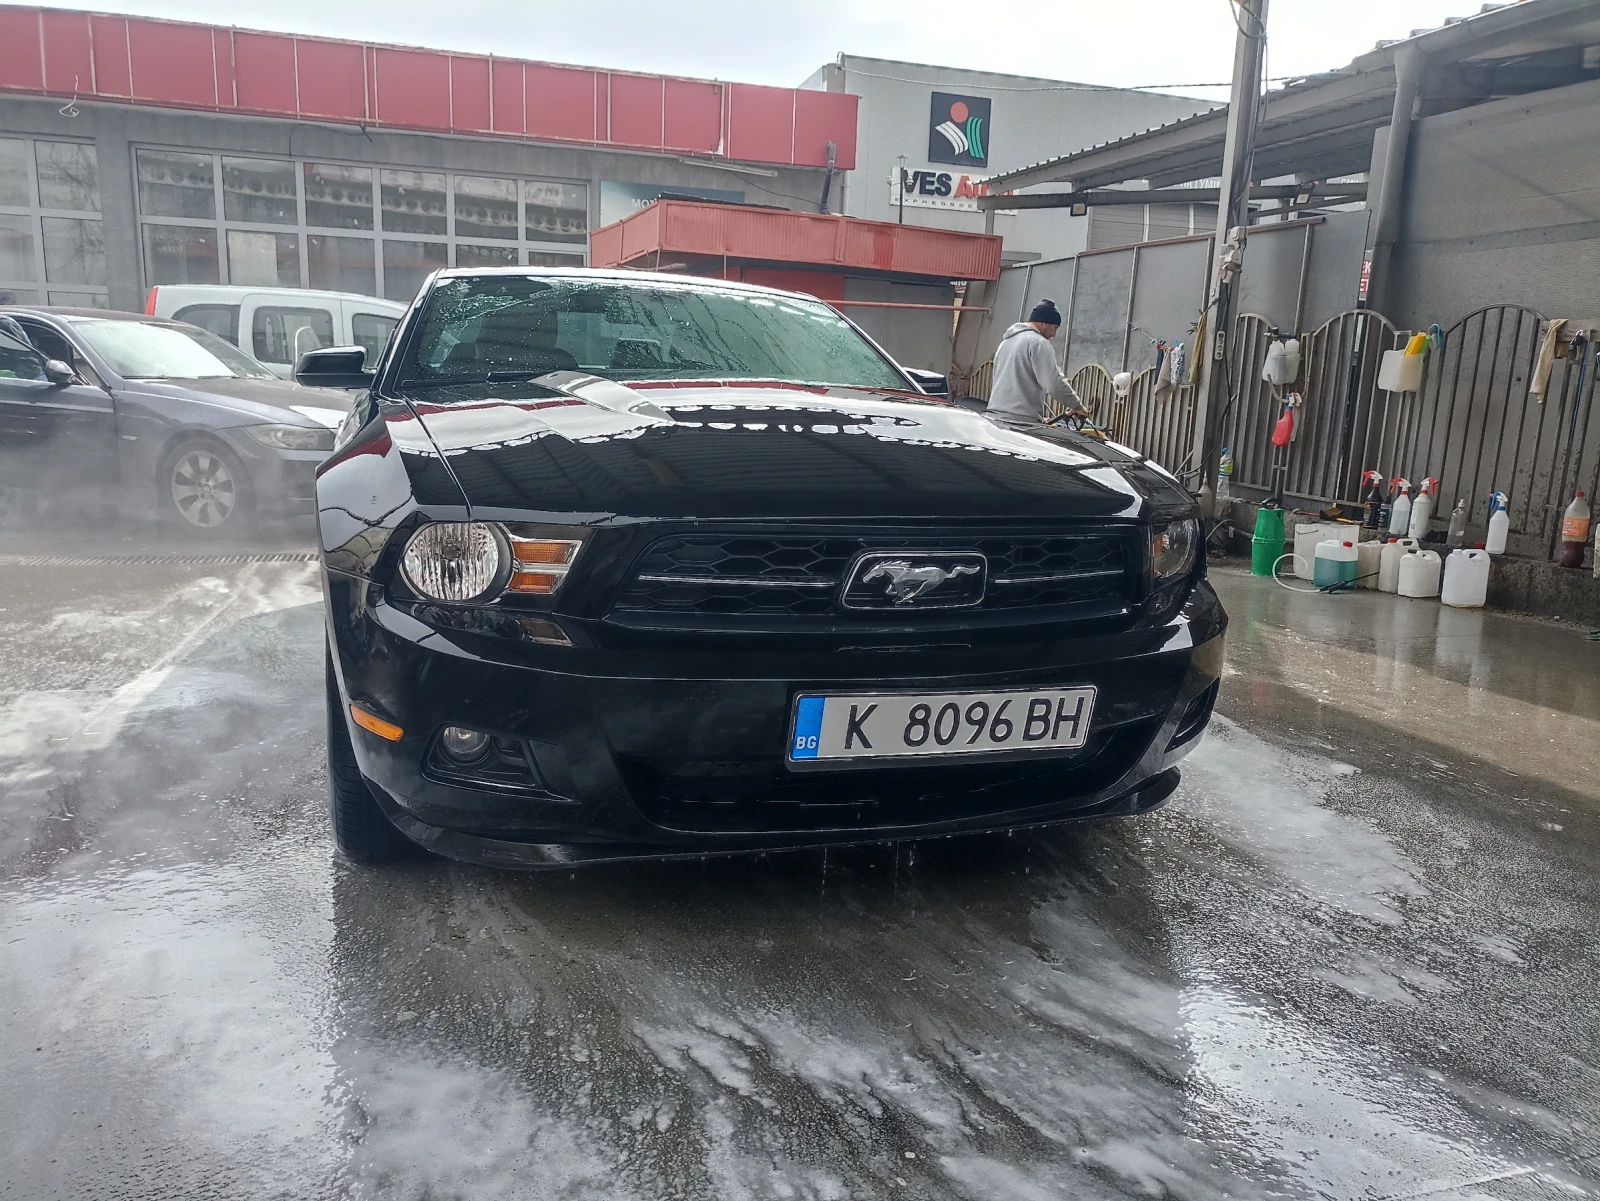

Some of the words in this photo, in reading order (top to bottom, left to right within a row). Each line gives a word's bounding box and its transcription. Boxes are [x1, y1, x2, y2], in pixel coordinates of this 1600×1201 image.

[902, 169, 953, 197] VES
[844, 703, 879, 750] K
[903, 699, 1013, 748] 8096
[1022, 696, 1086, 742] BH
[796, 735, 817, 750] BG
